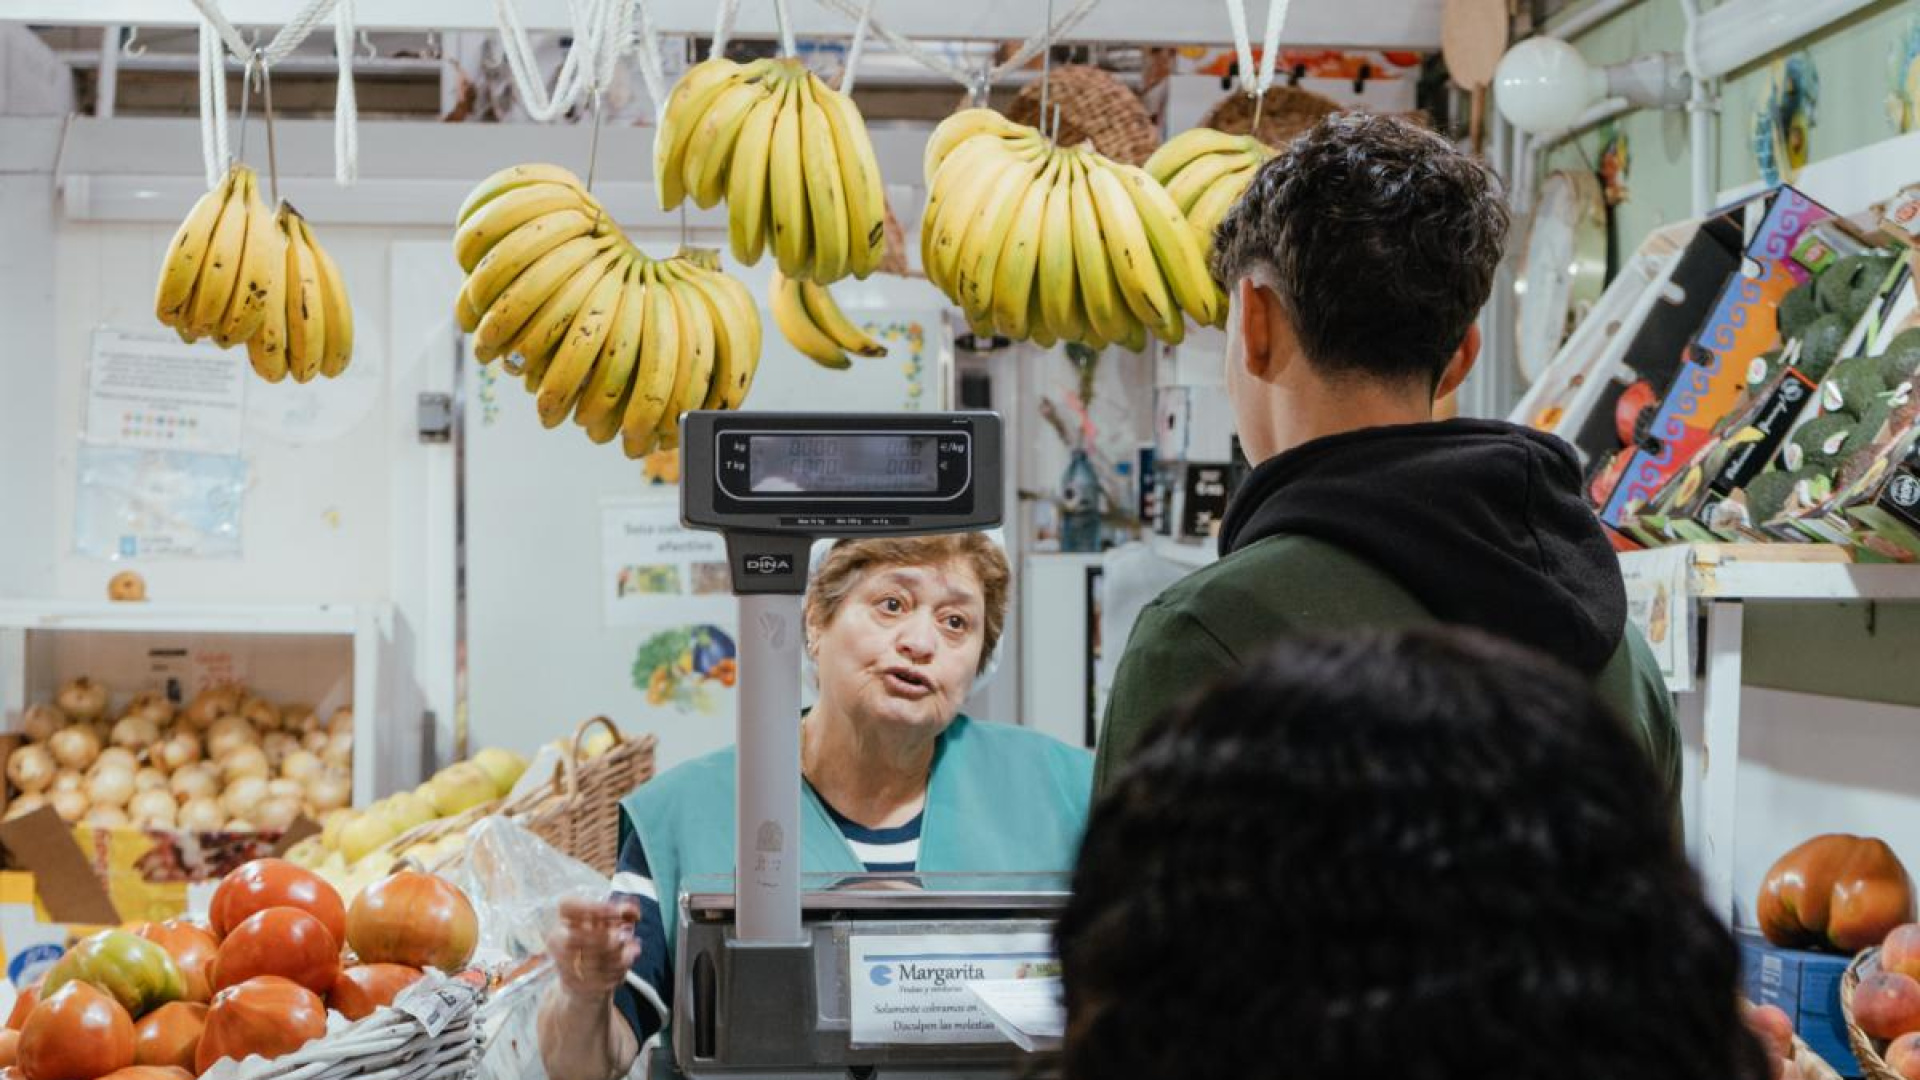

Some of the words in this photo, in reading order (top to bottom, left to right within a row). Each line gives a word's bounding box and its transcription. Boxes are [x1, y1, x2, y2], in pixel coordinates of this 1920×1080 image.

[733, 441, 746, 452] kg
[733, 461, 745, 471] kg
[746, 558, 790, 572] DINA
[899, 963, 985, 986] Margarita
[874, 1002, 920, 1013] Solamente
[921, 1002, 963, 1013] cobramos
[893, 1018, 937, 1033] Disculpen
[940, 1018, 952, 1030] las
[954, 1018, 996, 1030] molestias
